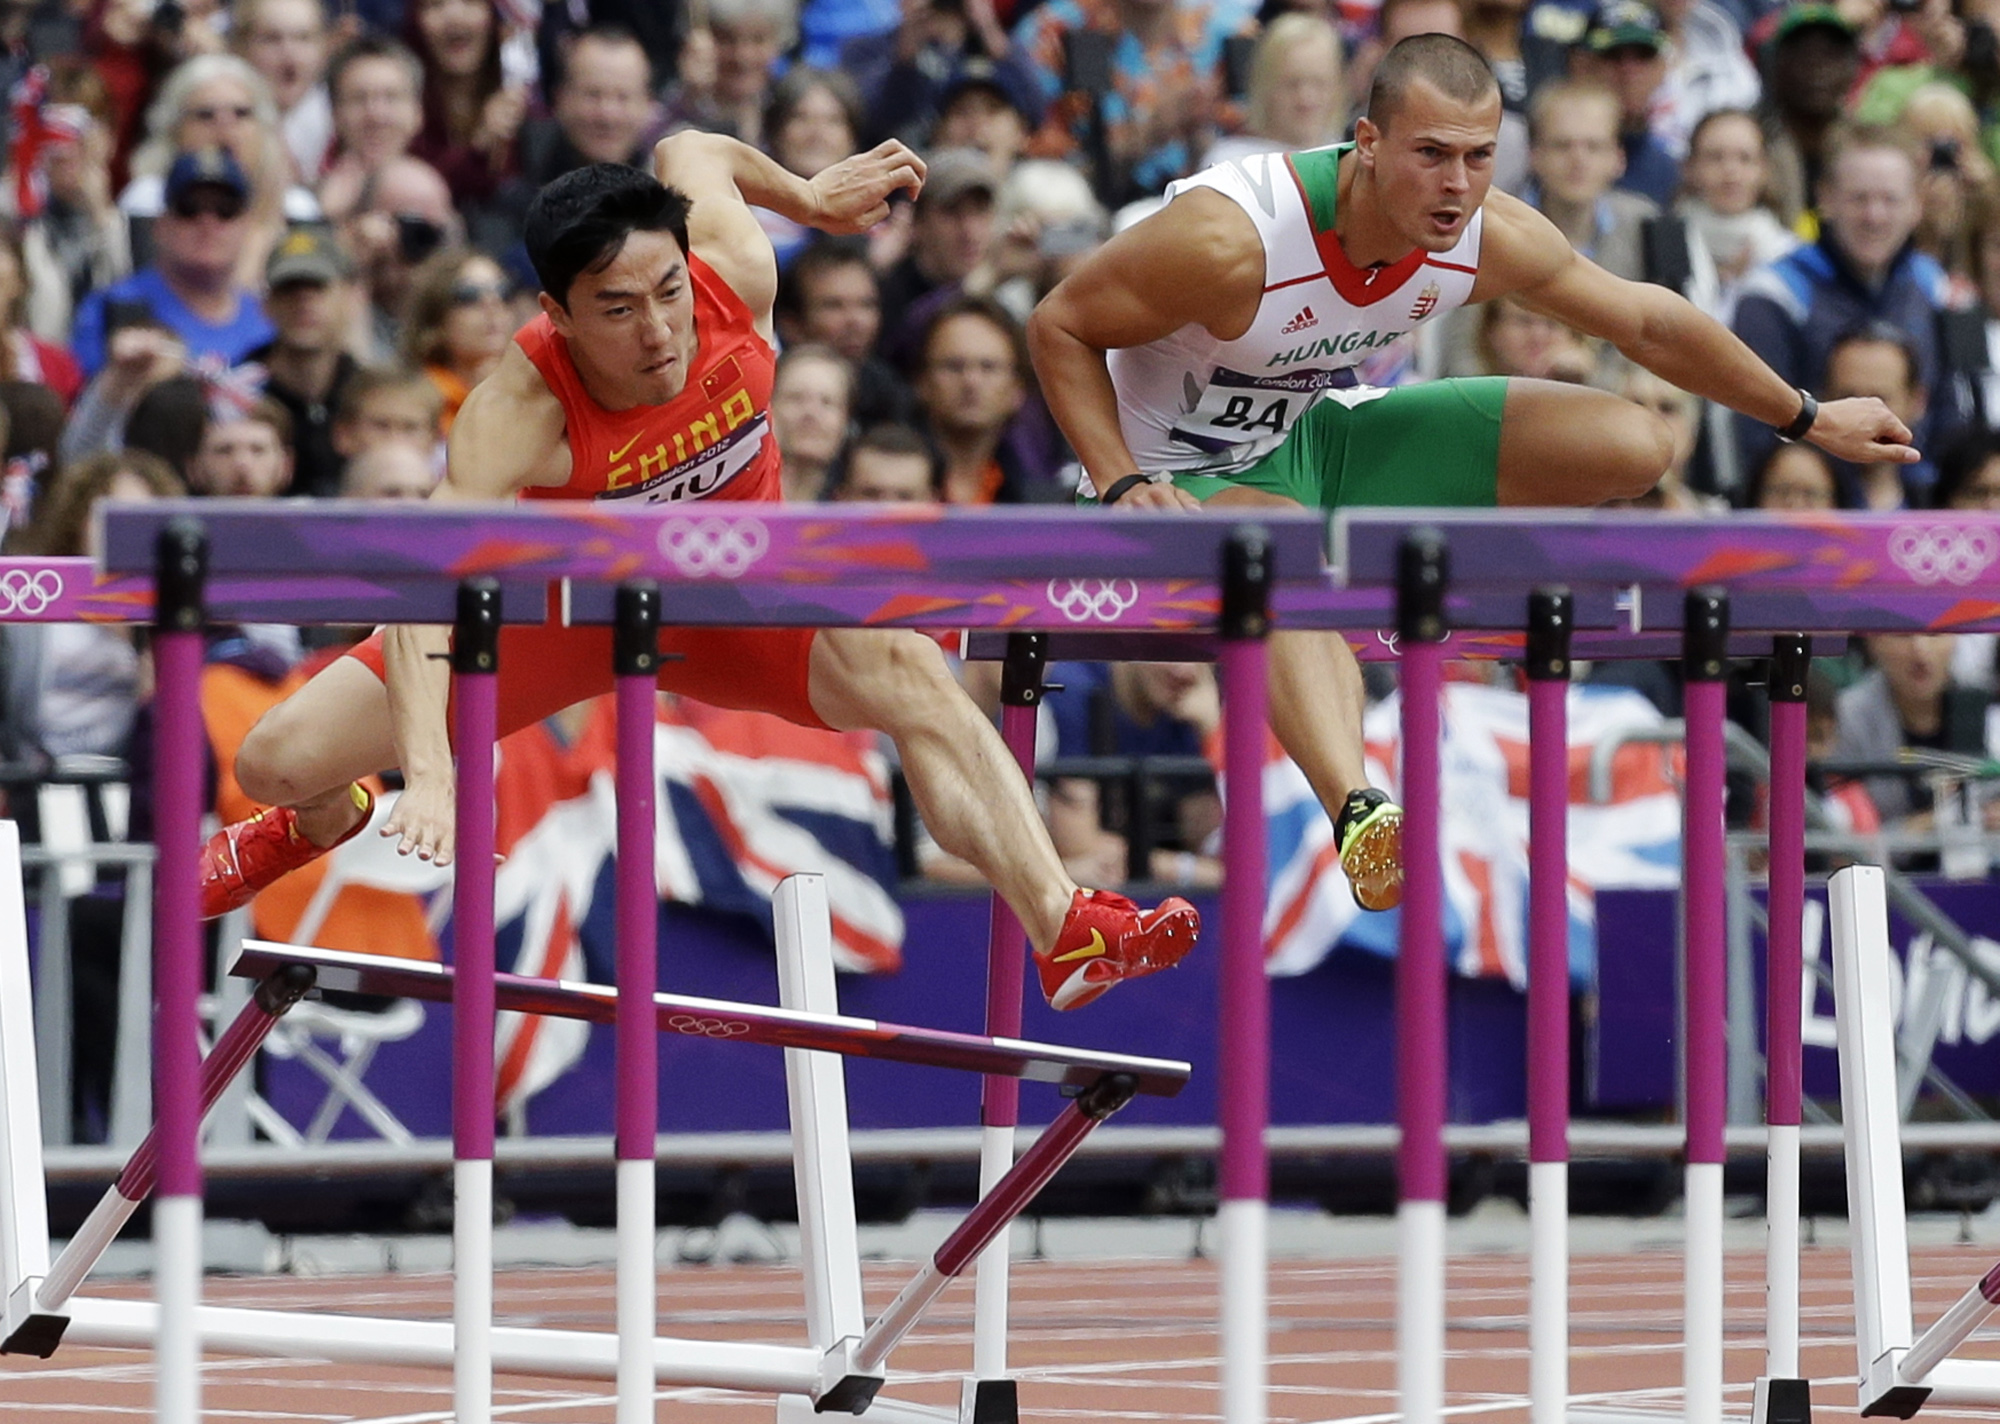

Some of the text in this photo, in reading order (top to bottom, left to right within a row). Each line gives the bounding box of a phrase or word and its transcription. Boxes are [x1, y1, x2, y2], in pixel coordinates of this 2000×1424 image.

[1281, 318, 1319, 335] adidas
[1265, 330, 1408, 367] HUNGAR
[1253, 372, 1333, 389] London 2012
[1209, 396, 1289, 435] BA
[606, 388, 755, 491] CHINA
[641, 438, 730, 490] London 2012
